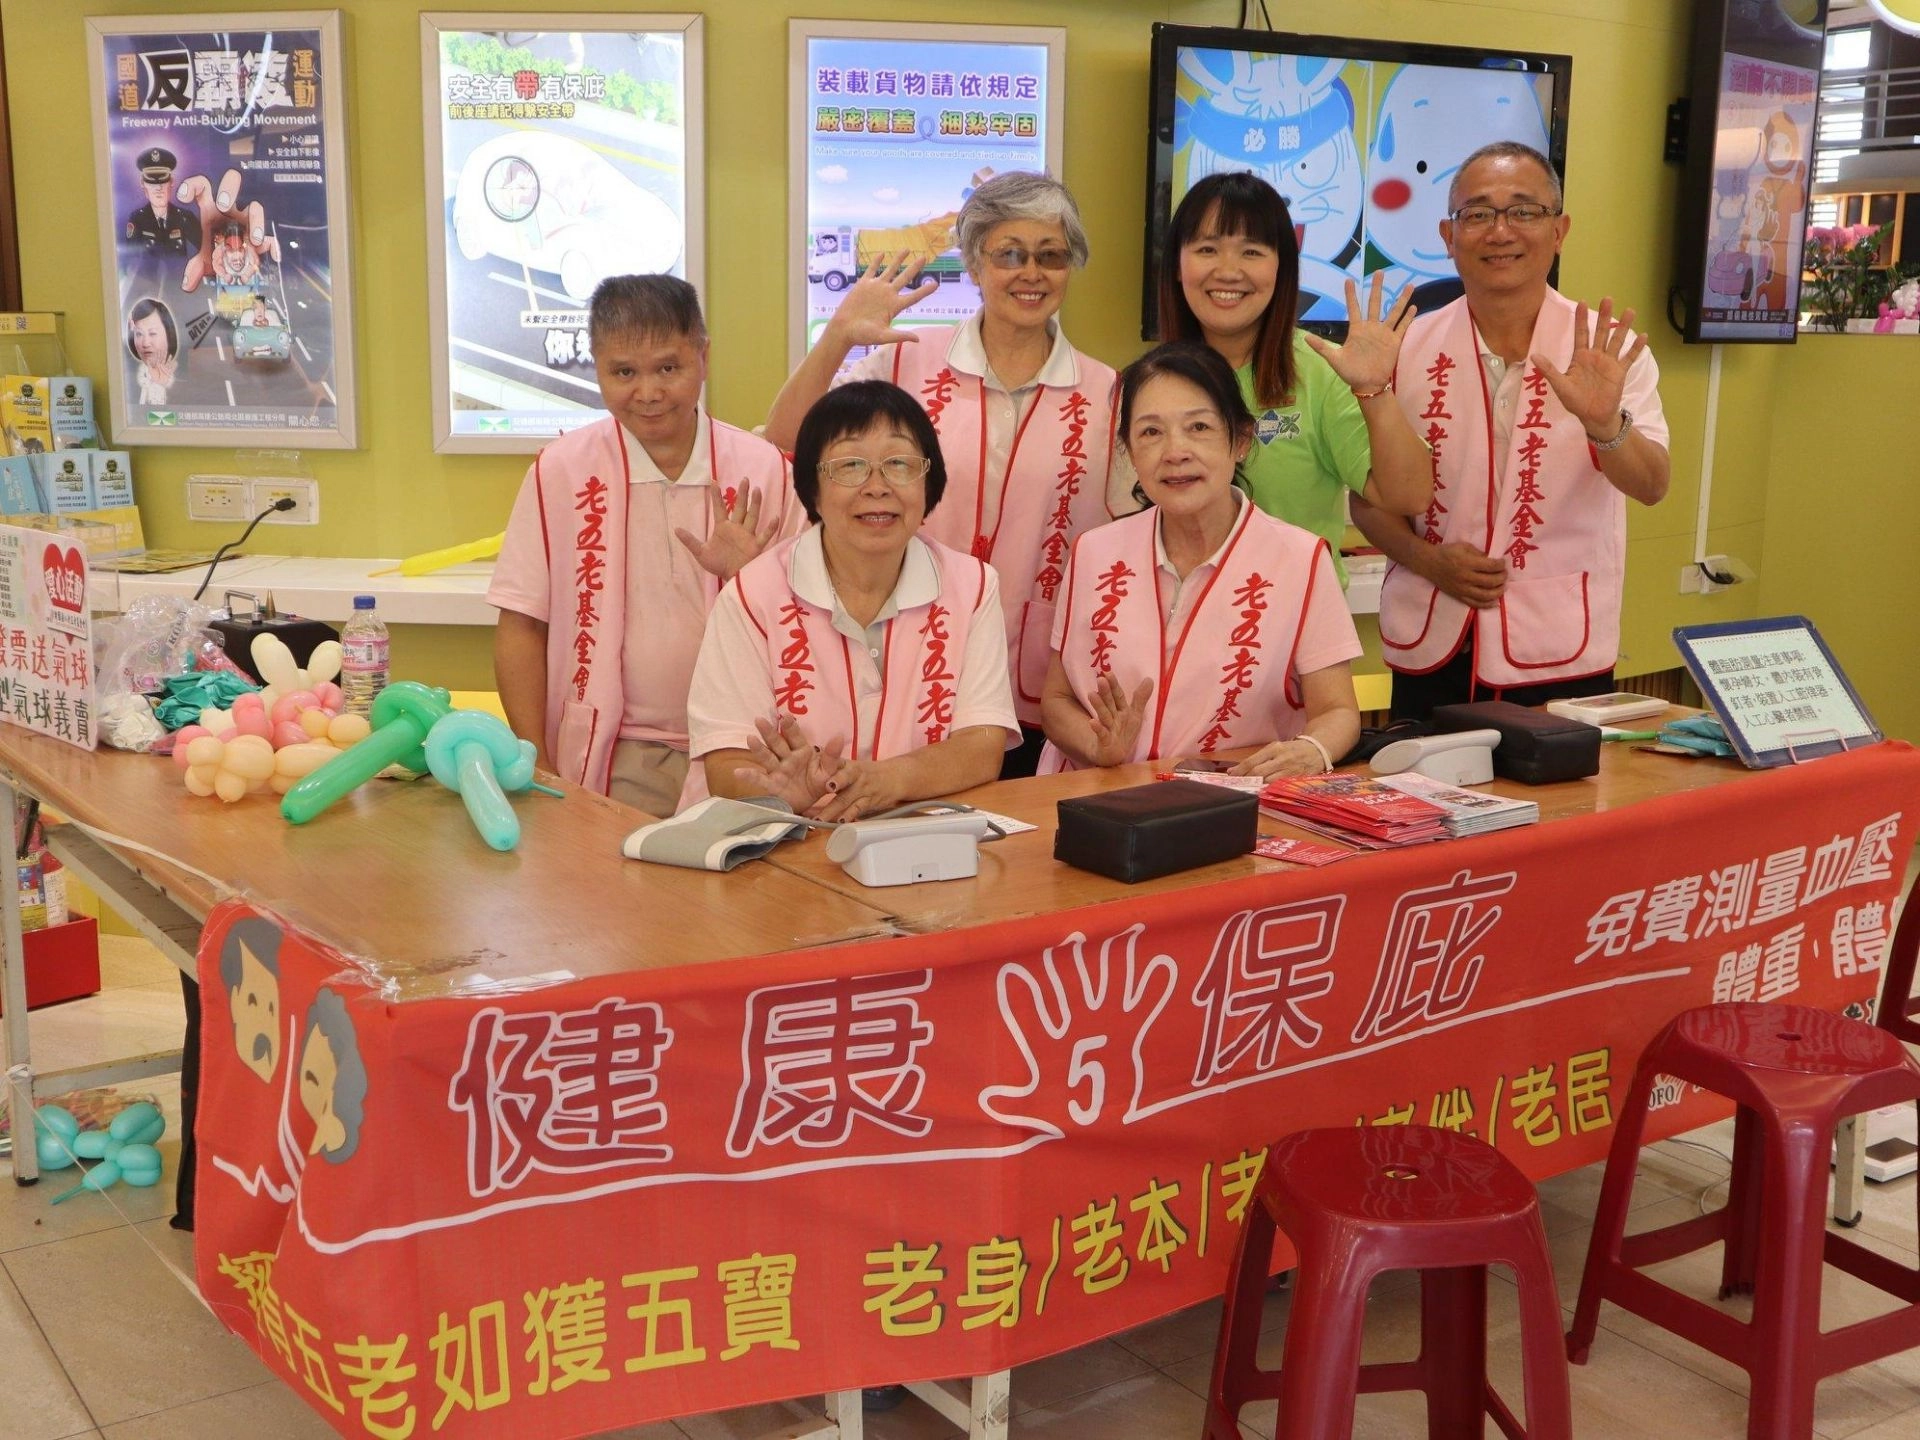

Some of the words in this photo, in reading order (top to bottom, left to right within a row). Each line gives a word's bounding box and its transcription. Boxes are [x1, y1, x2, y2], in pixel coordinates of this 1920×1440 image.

[116, 53, 140, 111] 國道
[292, 49, 316, 108] 運動
[448, 70, 605, 100] 安全有帶有保庇
[817, 68, 1039, 99] 裝載貨物請依規定
[121, 116, 171, 128] Freeway
[173, 114, 251, 127] Anti-Bullying
[253, 113, 317, 126] Movement
[449, 103, 576, 119] 前後座請記得繫安全帶
[815, 106, 916, 134] 嚴密覆蓋
[939, 109, 1038, 137] 捆紮牢固
[1242, 125, 1301, 152] 必勝
[1034, 391, 1092, 602] 老五老基金會
[573, 475, 608, 702] 老五老基金會
[1198, 572, 1274, 754] 老五老基金
[1574, 811, 1902, 965] 免費測量血壓
[448, 967, 934, 1197] 健康
[1067, 1034, 1108, 1126] 5
[1192, 868, 1518, 1087] 保庇
